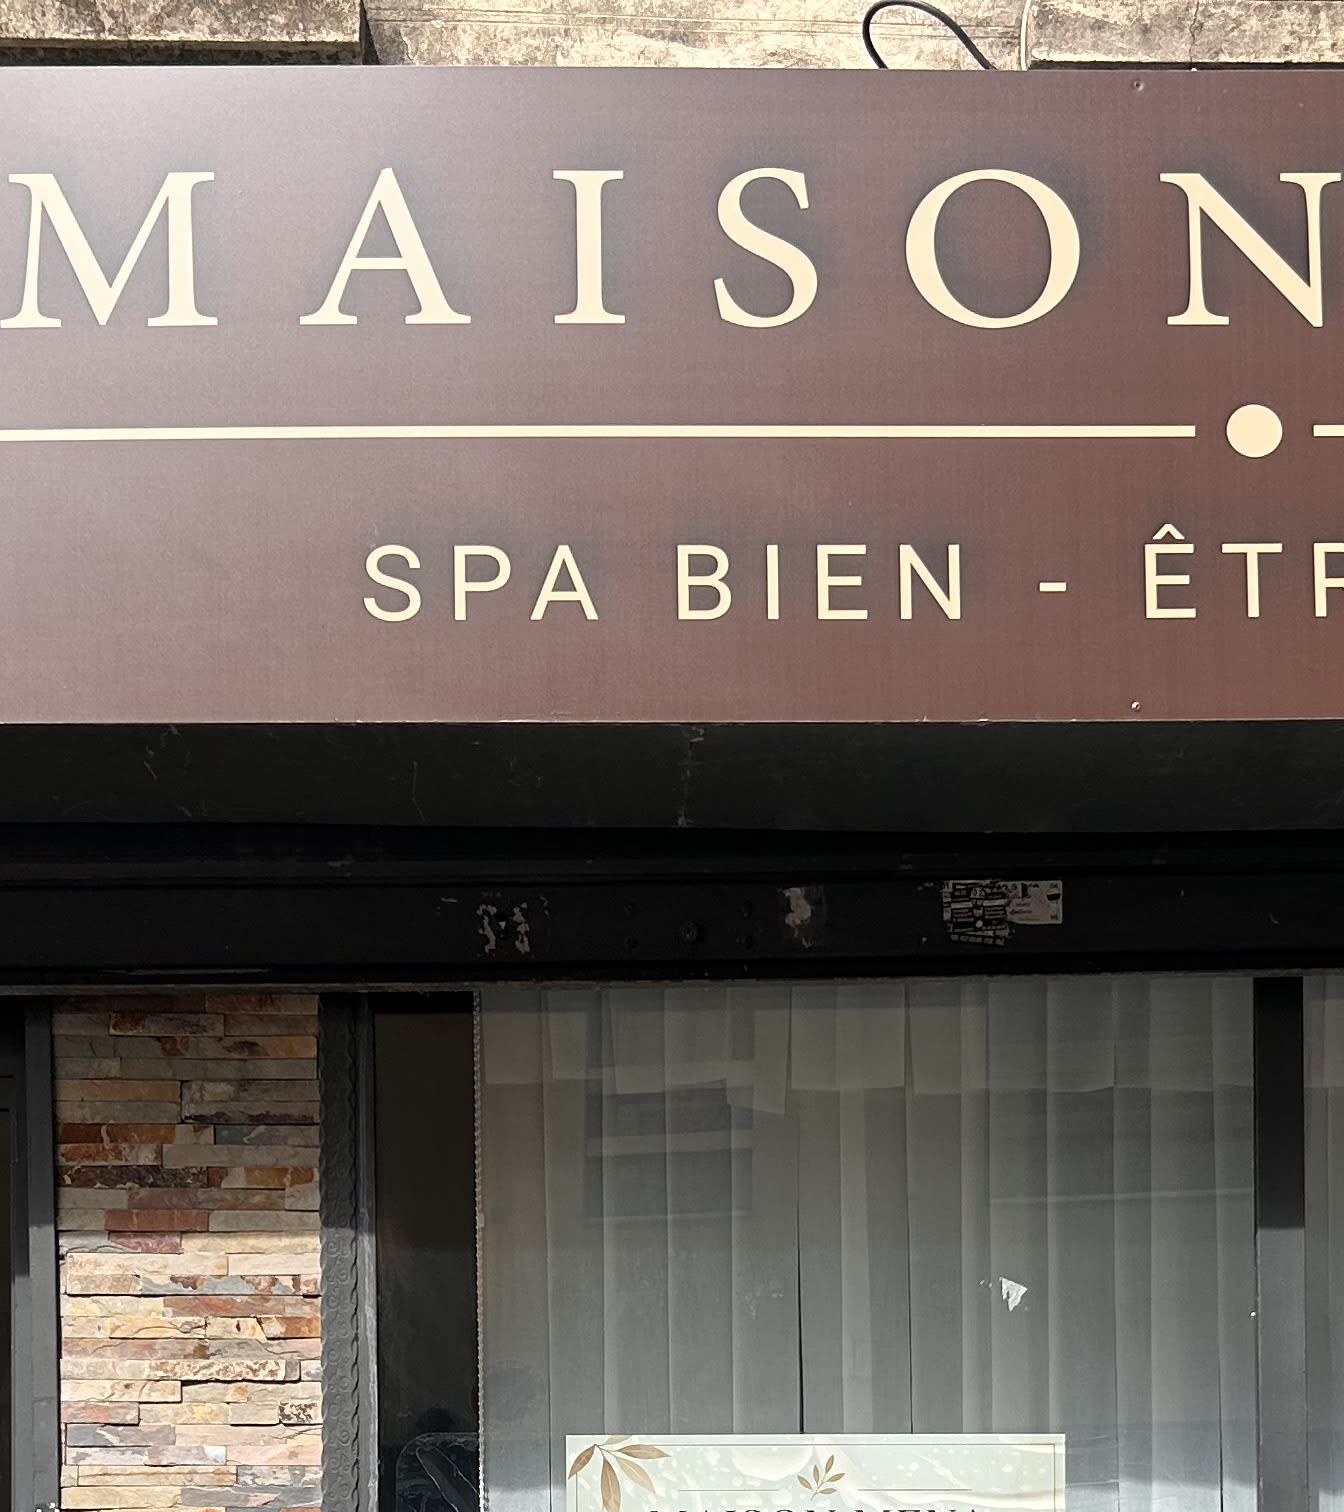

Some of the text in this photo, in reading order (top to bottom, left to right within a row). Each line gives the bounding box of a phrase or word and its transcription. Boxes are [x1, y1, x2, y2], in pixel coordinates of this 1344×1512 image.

[0, 166, 1340, 328] MAISON
[361, 542, 599, 623] SPA
[675, 542, 963, 622] BIEN
